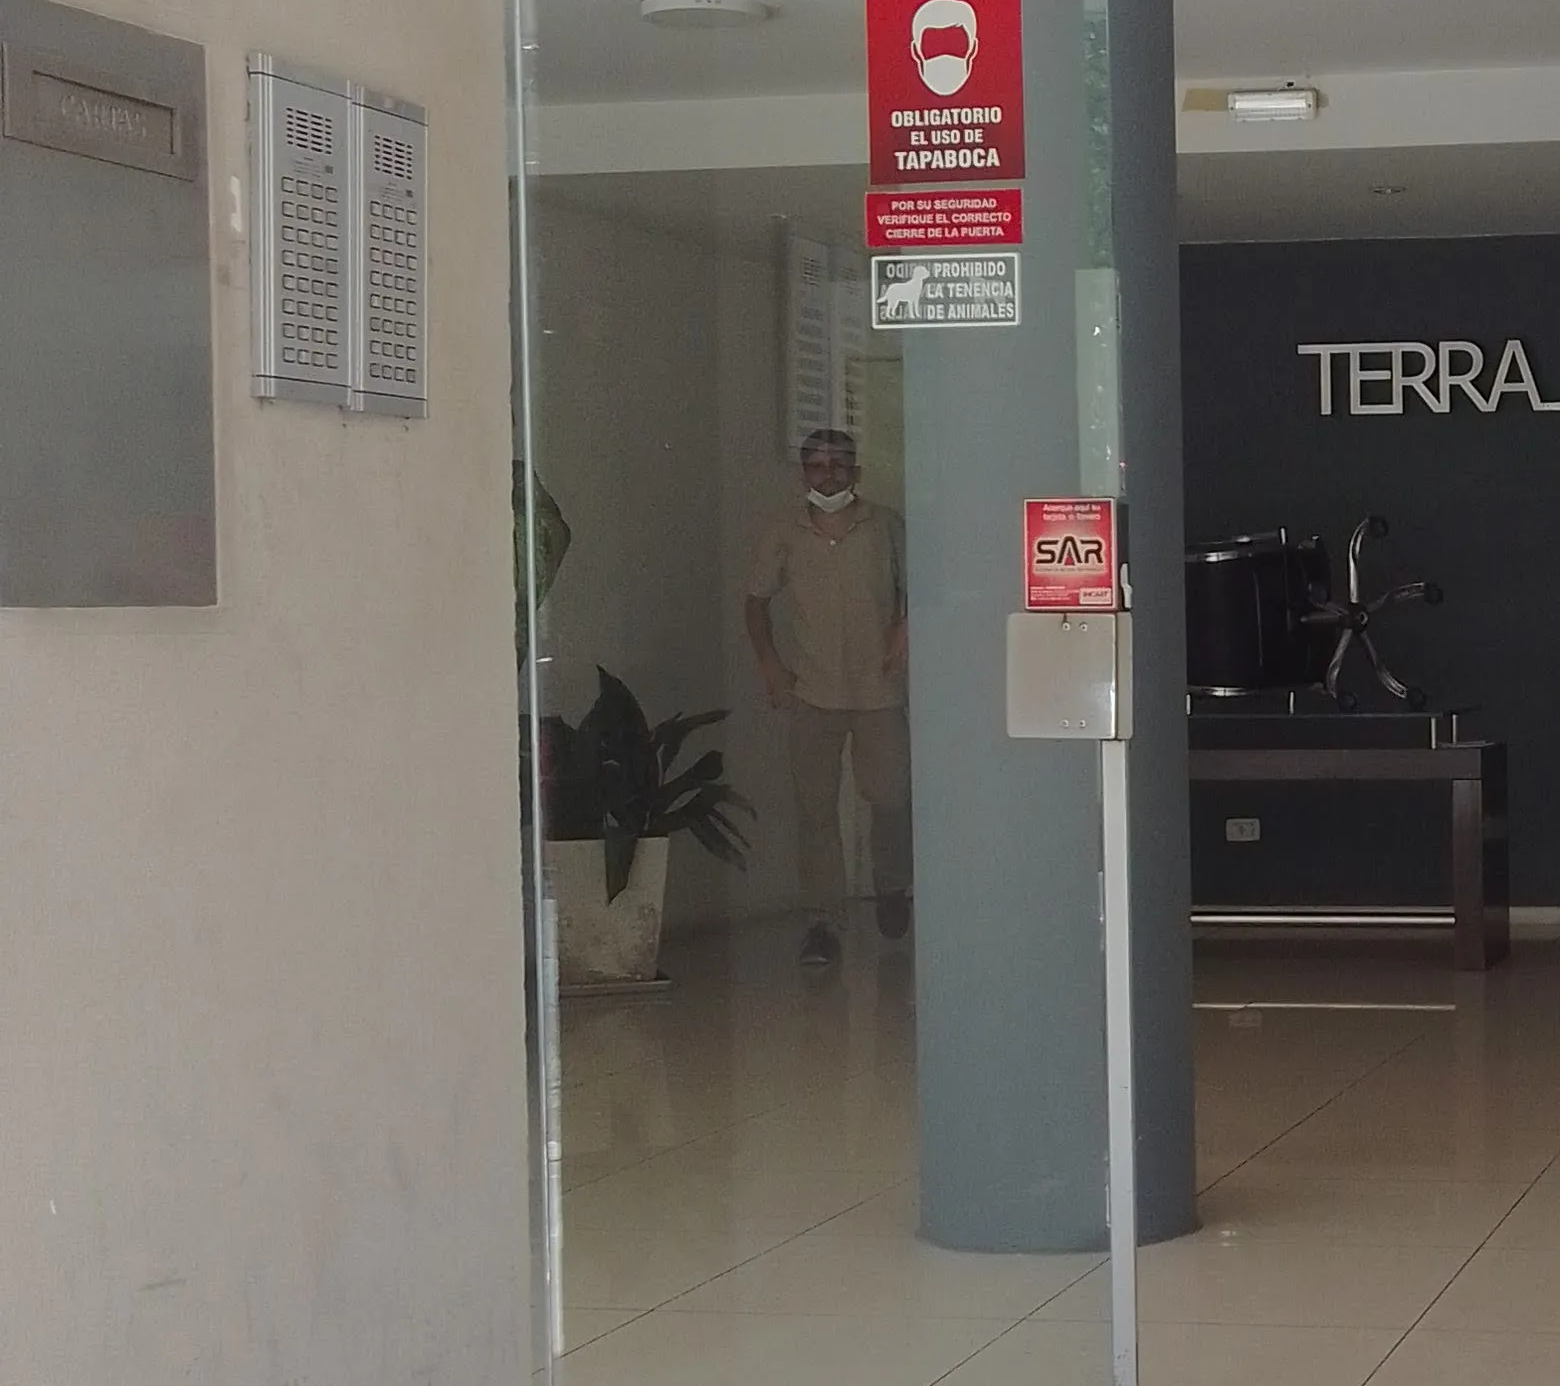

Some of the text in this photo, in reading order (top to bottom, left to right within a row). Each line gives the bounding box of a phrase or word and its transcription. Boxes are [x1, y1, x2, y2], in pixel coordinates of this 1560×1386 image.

[891, 107, 1002, 127] OBLIGATORIO
[911, 129, 984, 145] EL USO DE
[894, 148, 1000, 170] TAPABOCA
[891, 198, 997, 211] POR SU SEGURIDAD
[877, 212, 1012, 225] VERIFIQUE EL CORRECTO
[886, 226, 1004, 239] CIERRE DE LA PUERTA
[933, 261, 1006, 278] PROHIBIDO
[927, 281, 1014, 299] LA TENENCIA
[927, 304, 945, 320] DE
[947, 302, 1014, 319] ANIMALES
[1036, 536, 1104, 566] SAR
